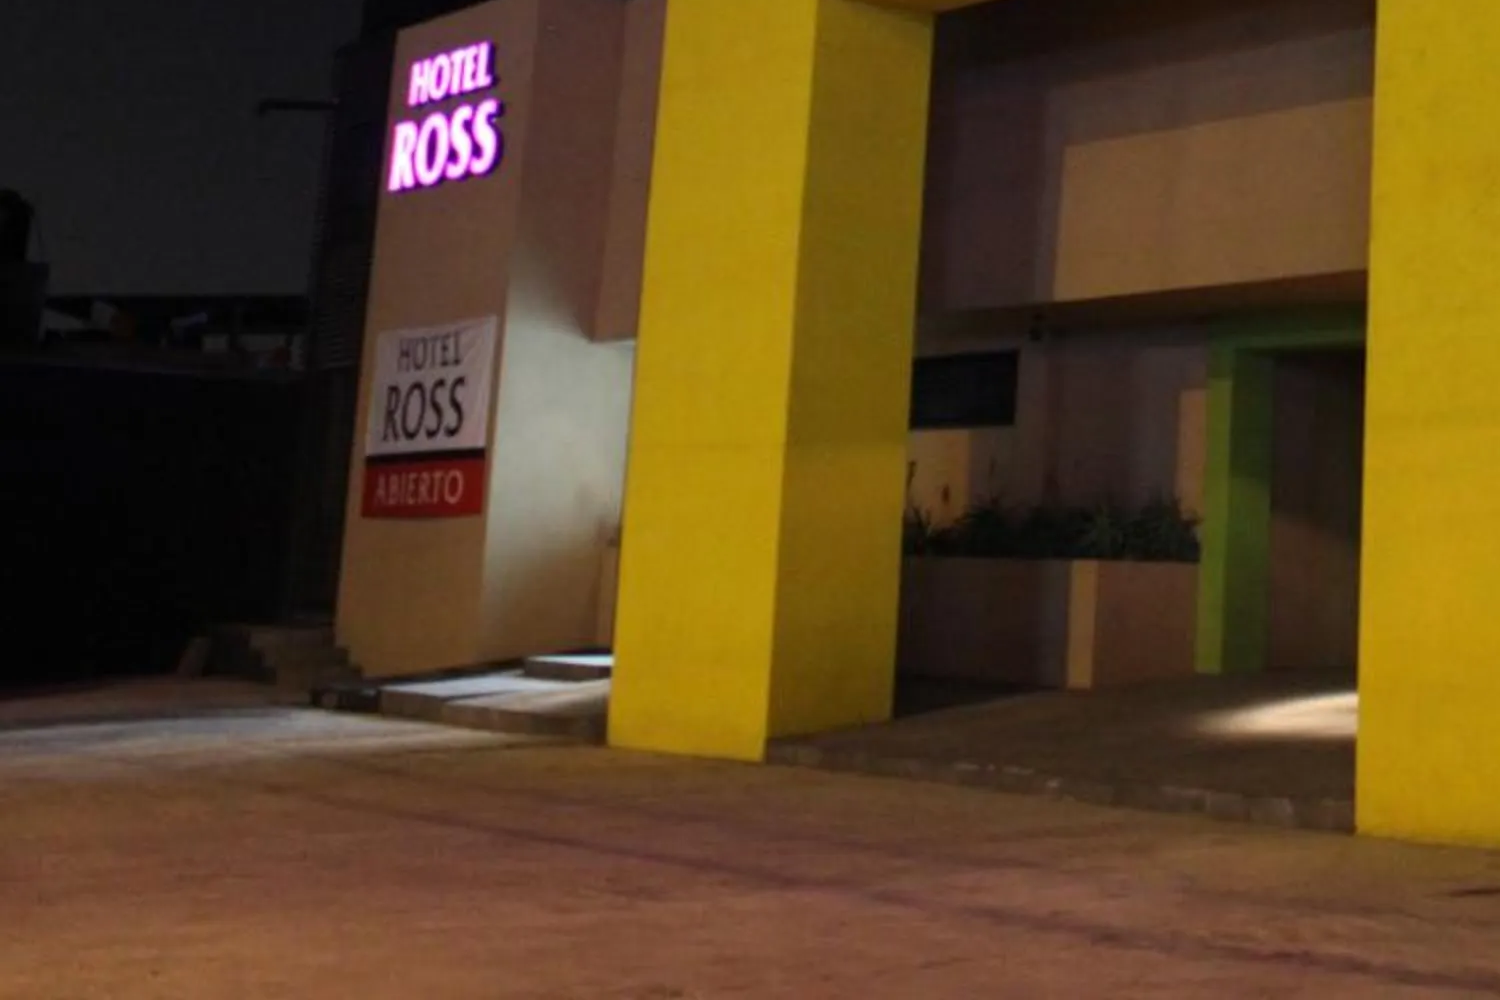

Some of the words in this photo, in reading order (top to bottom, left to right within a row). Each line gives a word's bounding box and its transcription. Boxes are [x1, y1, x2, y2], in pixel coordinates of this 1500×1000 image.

[407, 40, 497, 108] HOTEL
[387, 98, 502, 192] ROSS
[397, 330, 463, 373] HOTEL
[382, 375, 466, 442] ROSS
[373, 469, 465, 506] ABIERTO
